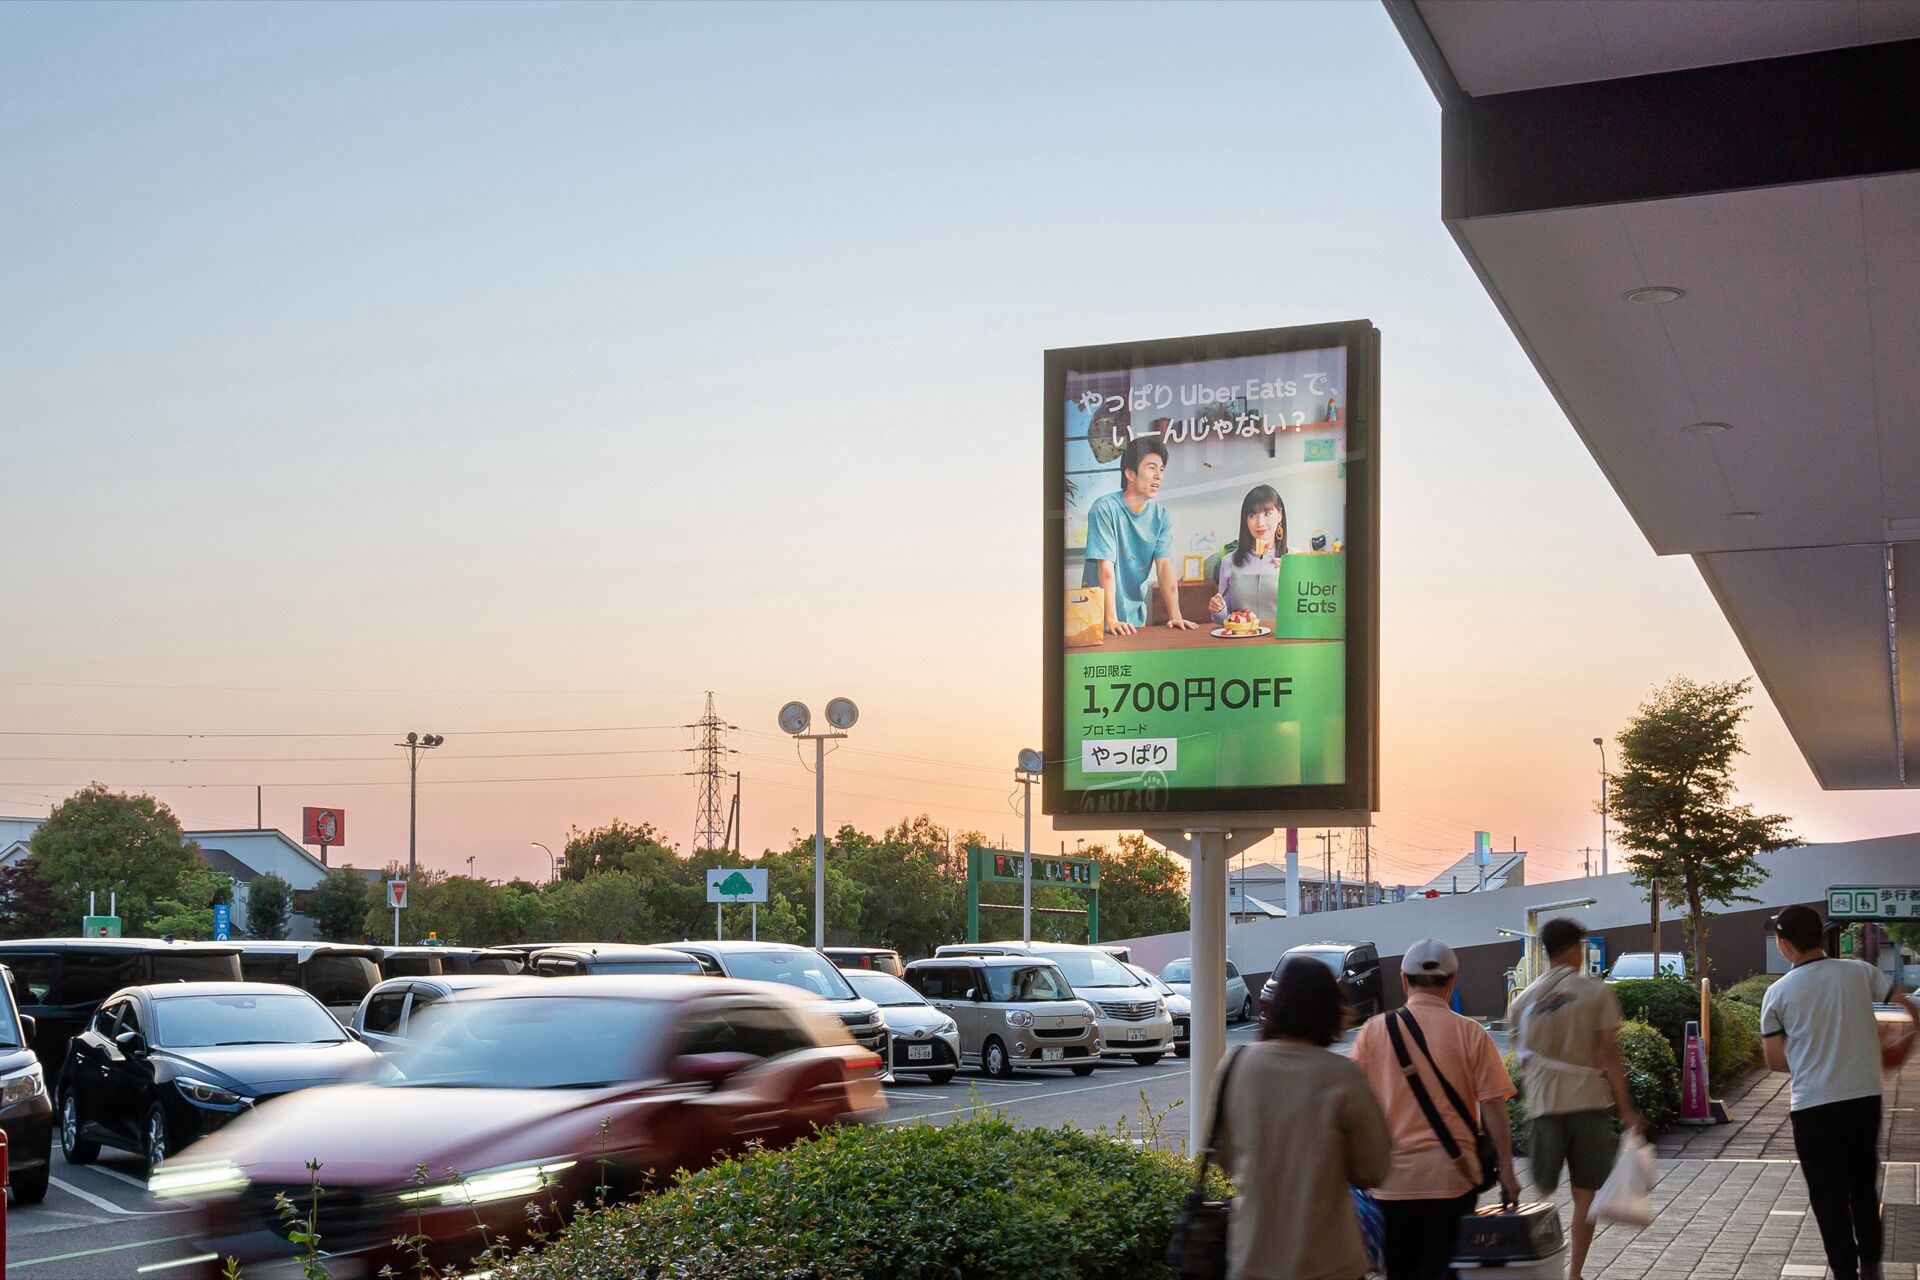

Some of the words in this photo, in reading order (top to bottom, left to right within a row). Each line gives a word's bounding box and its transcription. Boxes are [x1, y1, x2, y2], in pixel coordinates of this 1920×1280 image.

[1079, 383, 1173, 416] やっぱり
[1180, 383, 1240, 405] Uber
[1246, 377, 1297, 400] Eats
[1298, 581, 1337, 596] Uber
[1296, 598, 1337, 614] Eats
[1083, 664, 1132, 678] 初回限定
[1082, 677, 1293, 718] 1,700円OFF
[1083, 723, 1147, 736] プロモコード
[1091, 743, 1168, 766] やっぱり
